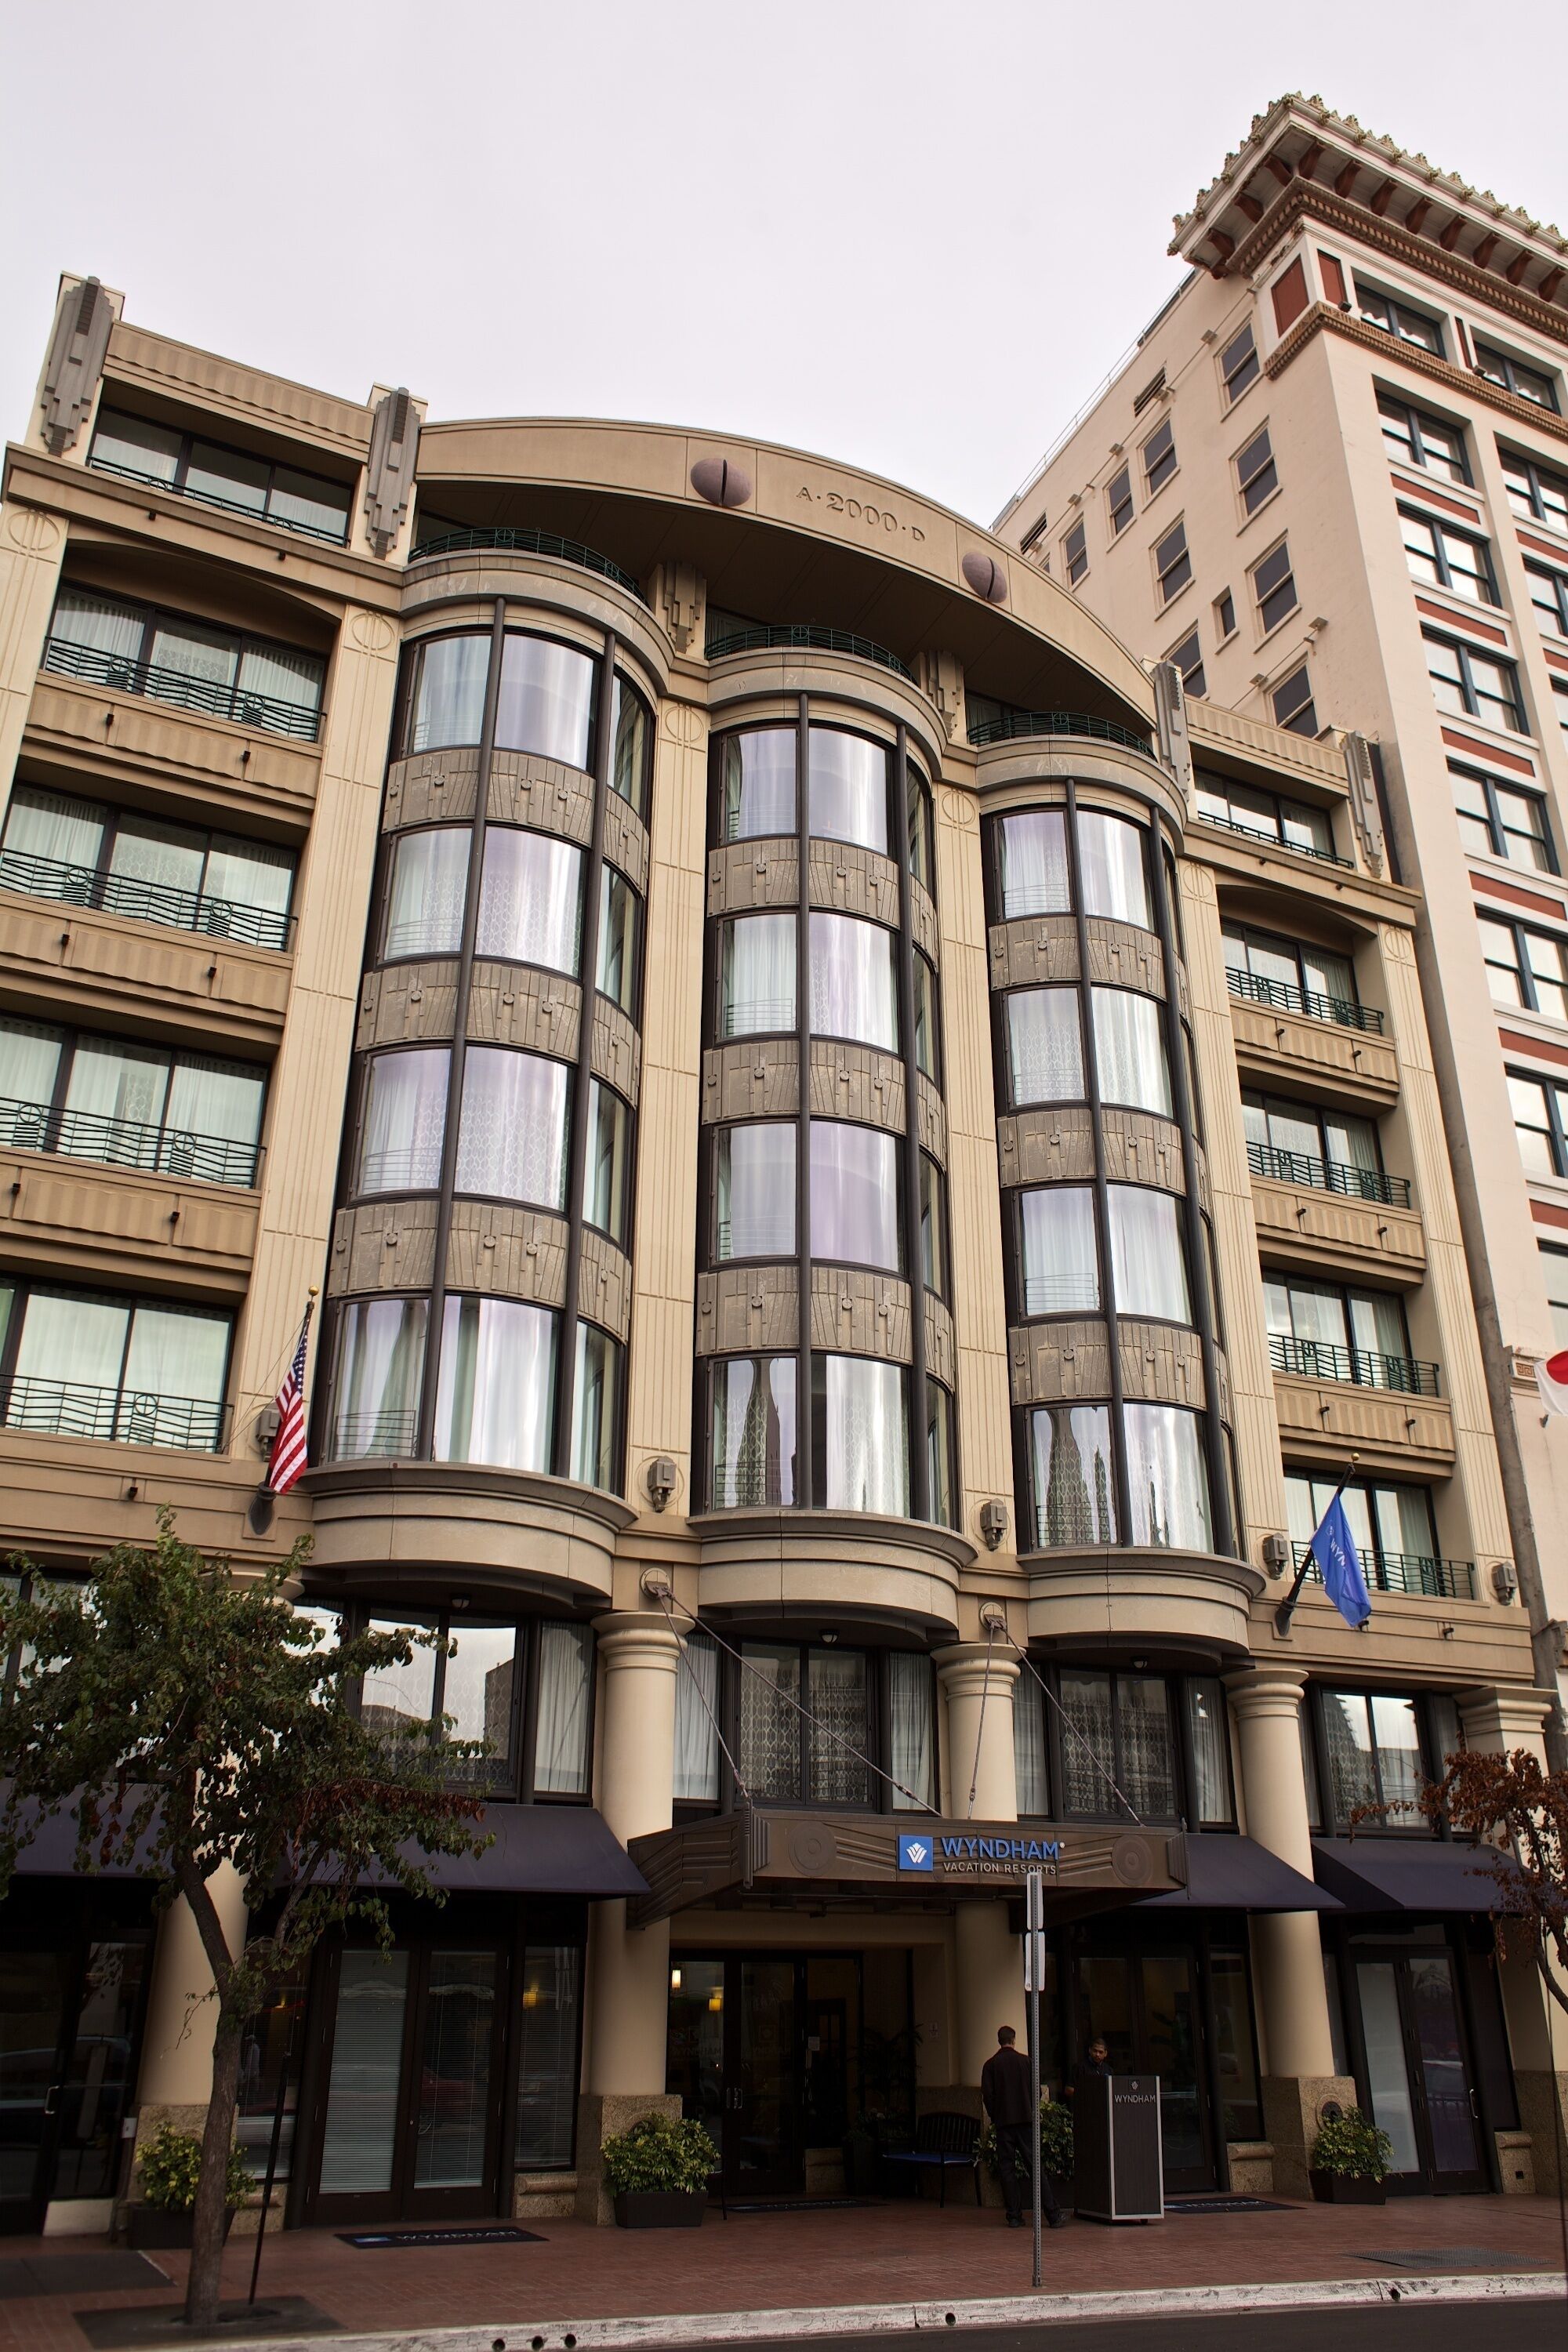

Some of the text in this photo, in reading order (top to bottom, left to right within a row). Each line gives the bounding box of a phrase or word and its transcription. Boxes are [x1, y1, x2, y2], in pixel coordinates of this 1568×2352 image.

[942, 1837, 1058, 1860] WYNDHAM
[943, 1861, 1056, 1875] VACATION RESORTS
[1114, 2094, 1156, 2103] WYNDHAM
